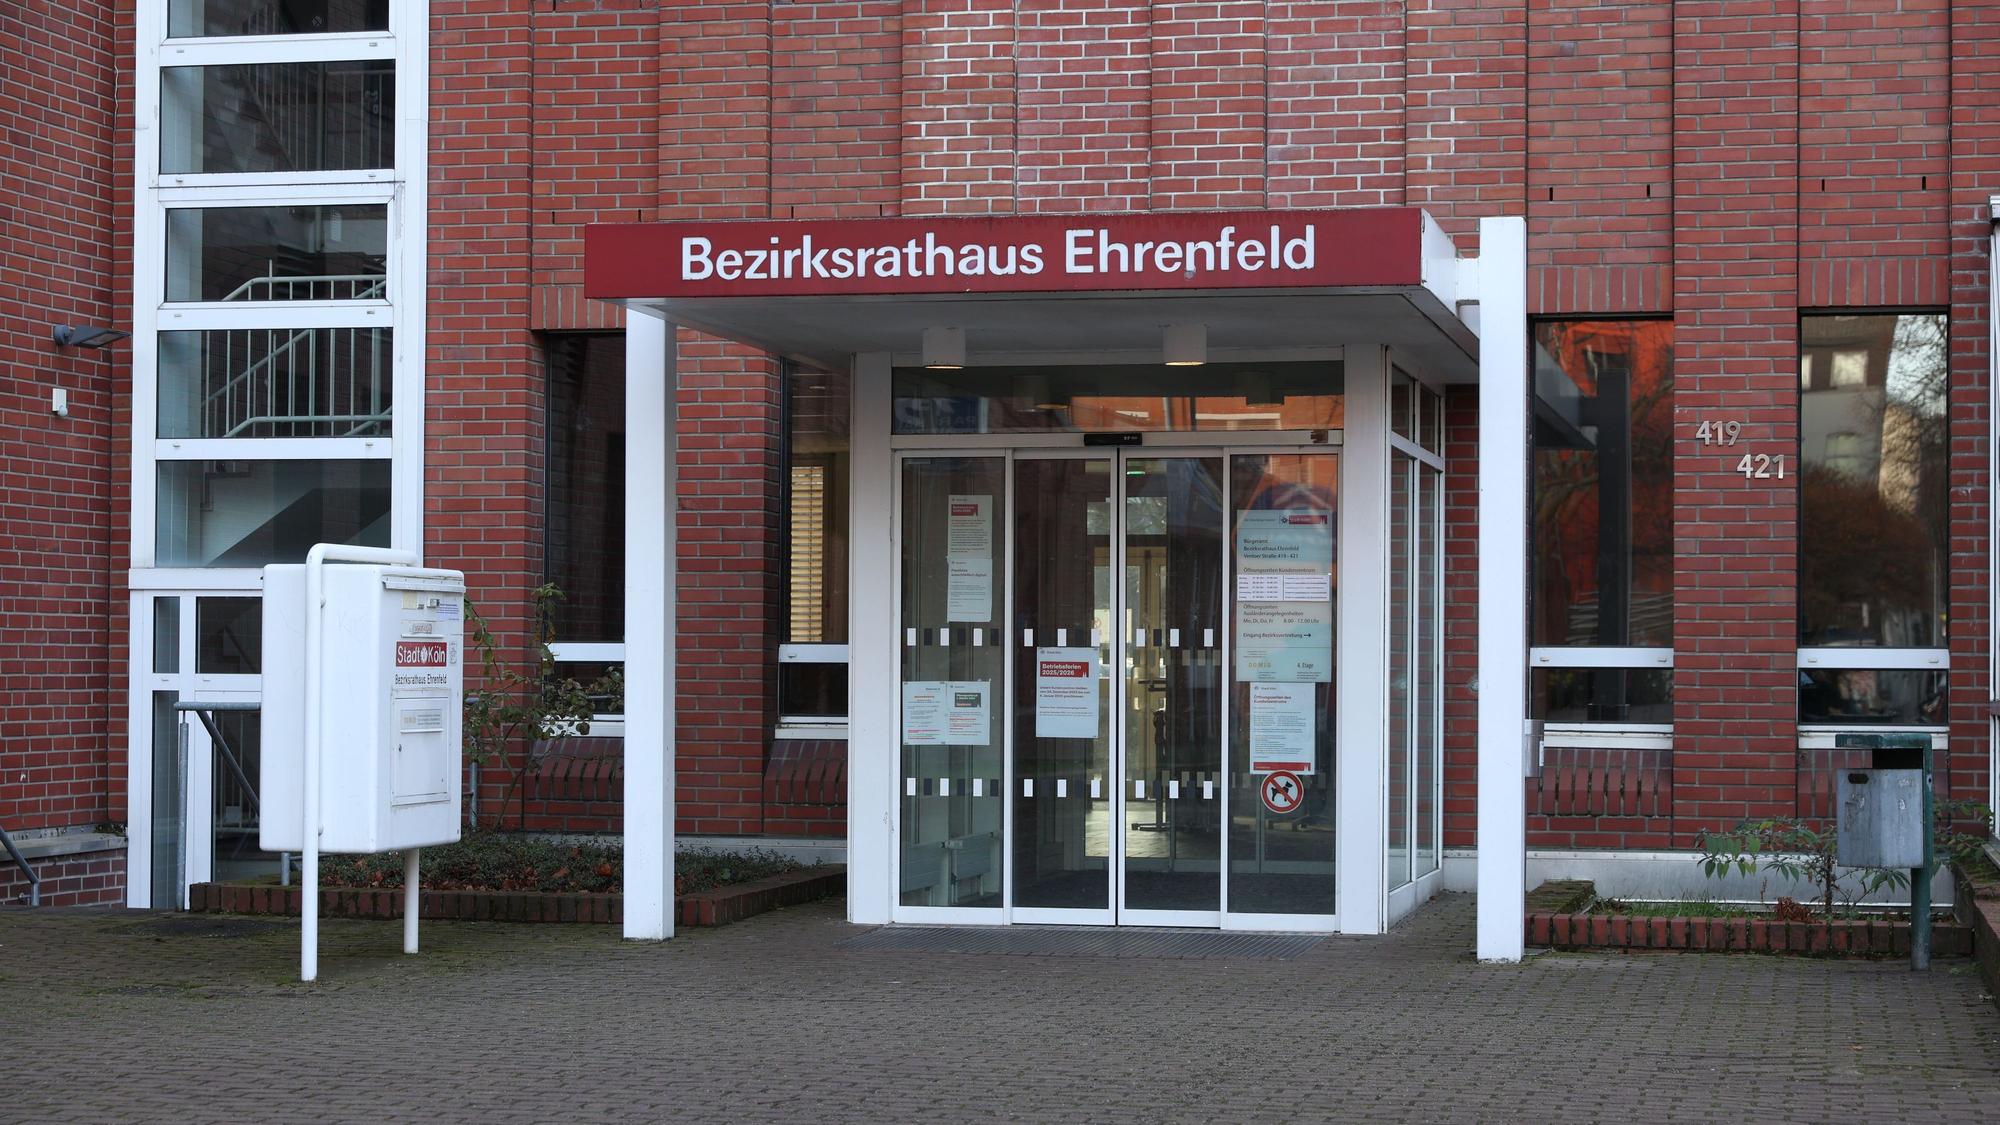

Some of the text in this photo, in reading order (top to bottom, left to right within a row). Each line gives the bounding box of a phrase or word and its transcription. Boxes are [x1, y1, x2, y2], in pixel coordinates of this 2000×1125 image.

[682, 224, 1314, 280] Bezirksrathaus Ehrenfeld
[1695, 420, 1741, 446] 419
[1737, 453, 1785, 479] 421
[397, 645, 421, 664] Stadt
[427, 644, 446, 664] Köln
[395, 673, 447, 685] Bezirksrathaus Ehrenfeld
